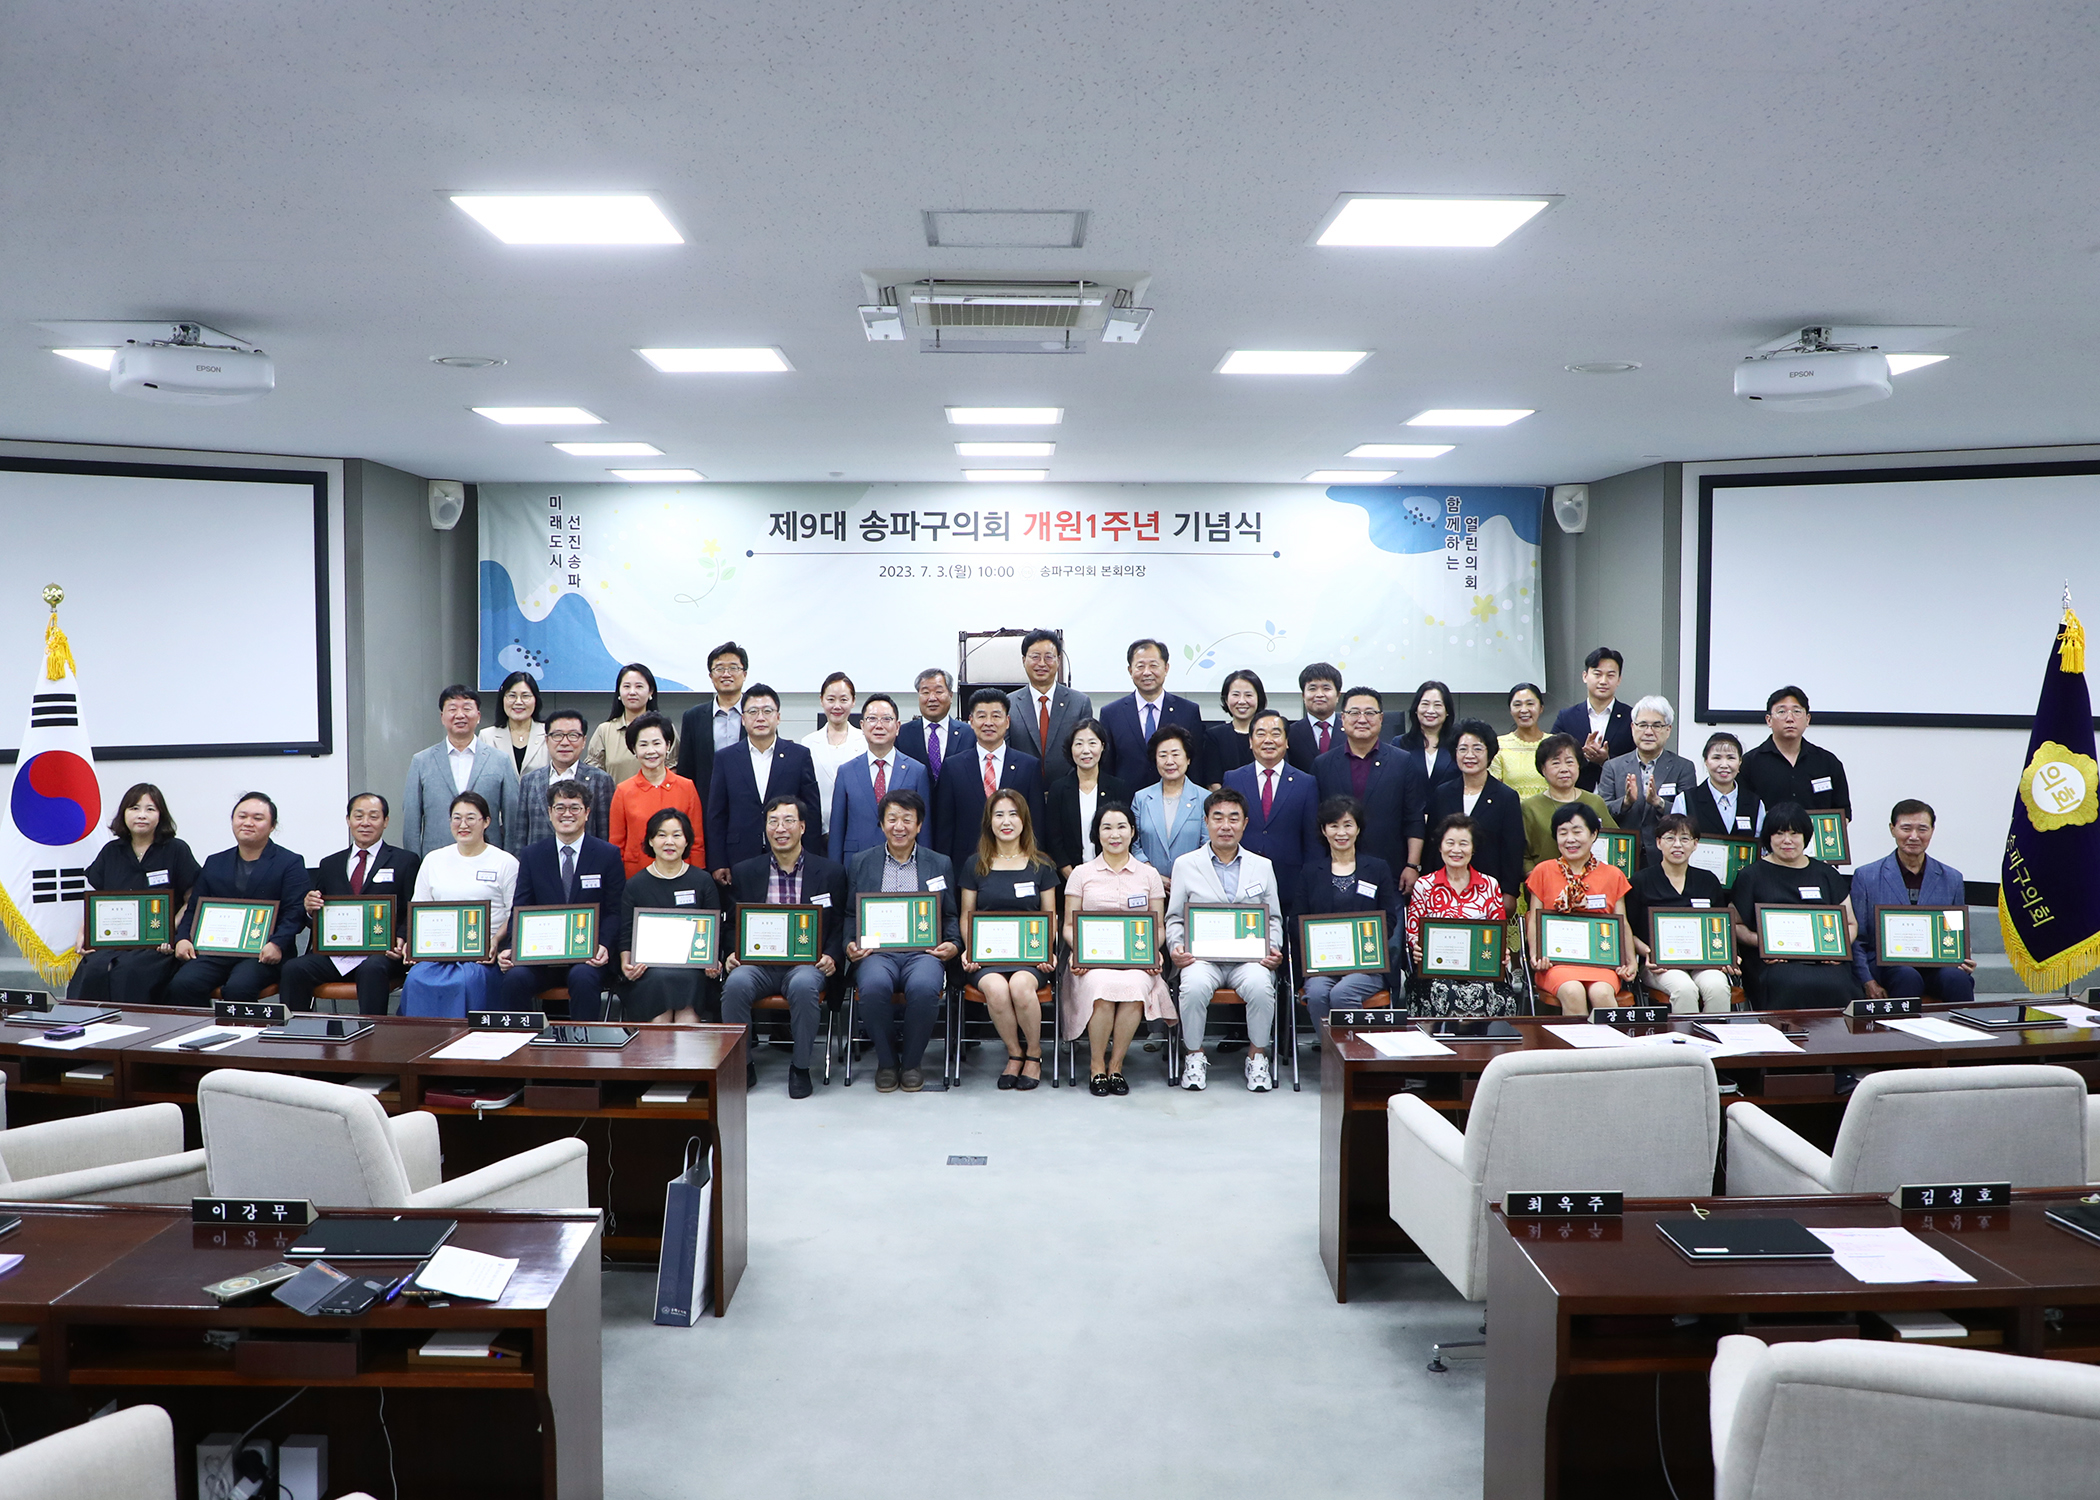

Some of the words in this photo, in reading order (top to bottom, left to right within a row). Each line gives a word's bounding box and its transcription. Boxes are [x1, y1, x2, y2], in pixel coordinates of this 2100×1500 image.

[195, 364, 222, 373] EPSON
[1789, 370, 1815, 379] EPSON
[549, 495, 563, 569] 미래도시
[768, 510, 847, 542] 제9대
[858, 509, 1009, 543] 송파구의회
[1022, 510, 1161, 543] 개원1주년
[1173, 511, 1262, 543] 기념식
[1446, 497, 1461, 570] 함께하는
[567, 515, 582, 588] 선진송파
[1464, 517, 1478, 590] 열린의회
[878, 565, 915, 578] 2023.
[920, 565, 932, 578] 7.
[978, 565, 1015, 578] 10:00
[1040, 565, 1097, 578] 송파구의회
[1101, 565, 1147, 578] 본회의장
[2039, 766, 2081, 812] 의회
[1865, 1000, 1911, 1014] 박종현
[480, 1014, 531, 1027] 최상진
[1343, 1012, 1395, 1024] 정주리
[1605, 1010, 1657, 1023] 장원만
[1527, 1196, 1604, 1213] 최옥주
[1921, 1188, 1993, 1206] 김성호
[212, 1202, 288, 1221] 이강무
